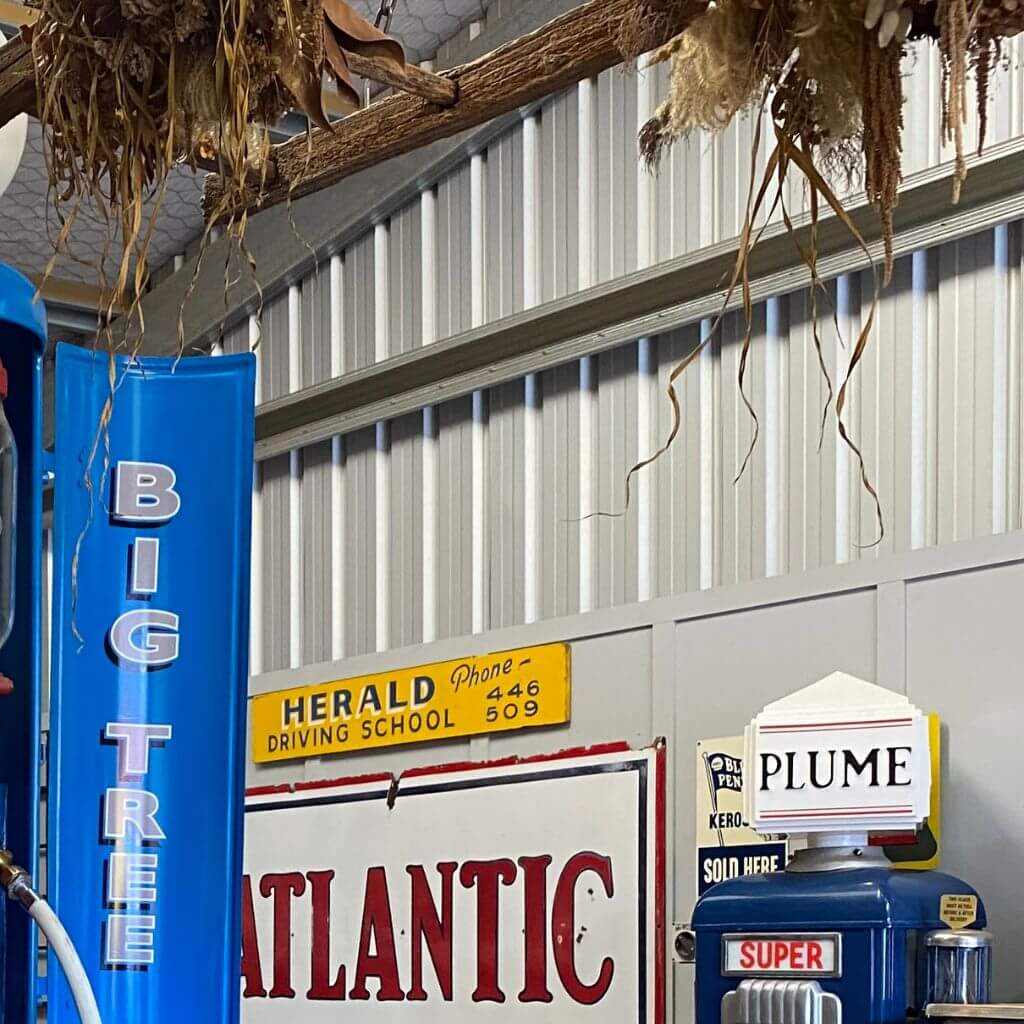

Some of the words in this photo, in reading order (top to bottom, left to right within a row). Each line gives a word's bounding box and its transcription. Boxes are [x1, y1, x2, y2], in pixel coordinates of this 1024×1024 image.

[110, 460, 181, 666] BIG
[281, 674, 437, 728] HERALD
[486, 679, 541, 701] 446
[267, 722, 350, 753] DRIVING
[361, 707, 455, 740] SCHOOL
[486, 700, 540, 723] 509
[725, 758, 744, 773] BL
[759, 746, 913, 792] PLUME
[709, 811, 750, 829] KERO
[103, 721, 173, 966] TREE
[703, 857, 739, 884] SOLD
[240, 849, 615, 1006] ATLANTIC
[738, 939, 824, 971] SUPER
